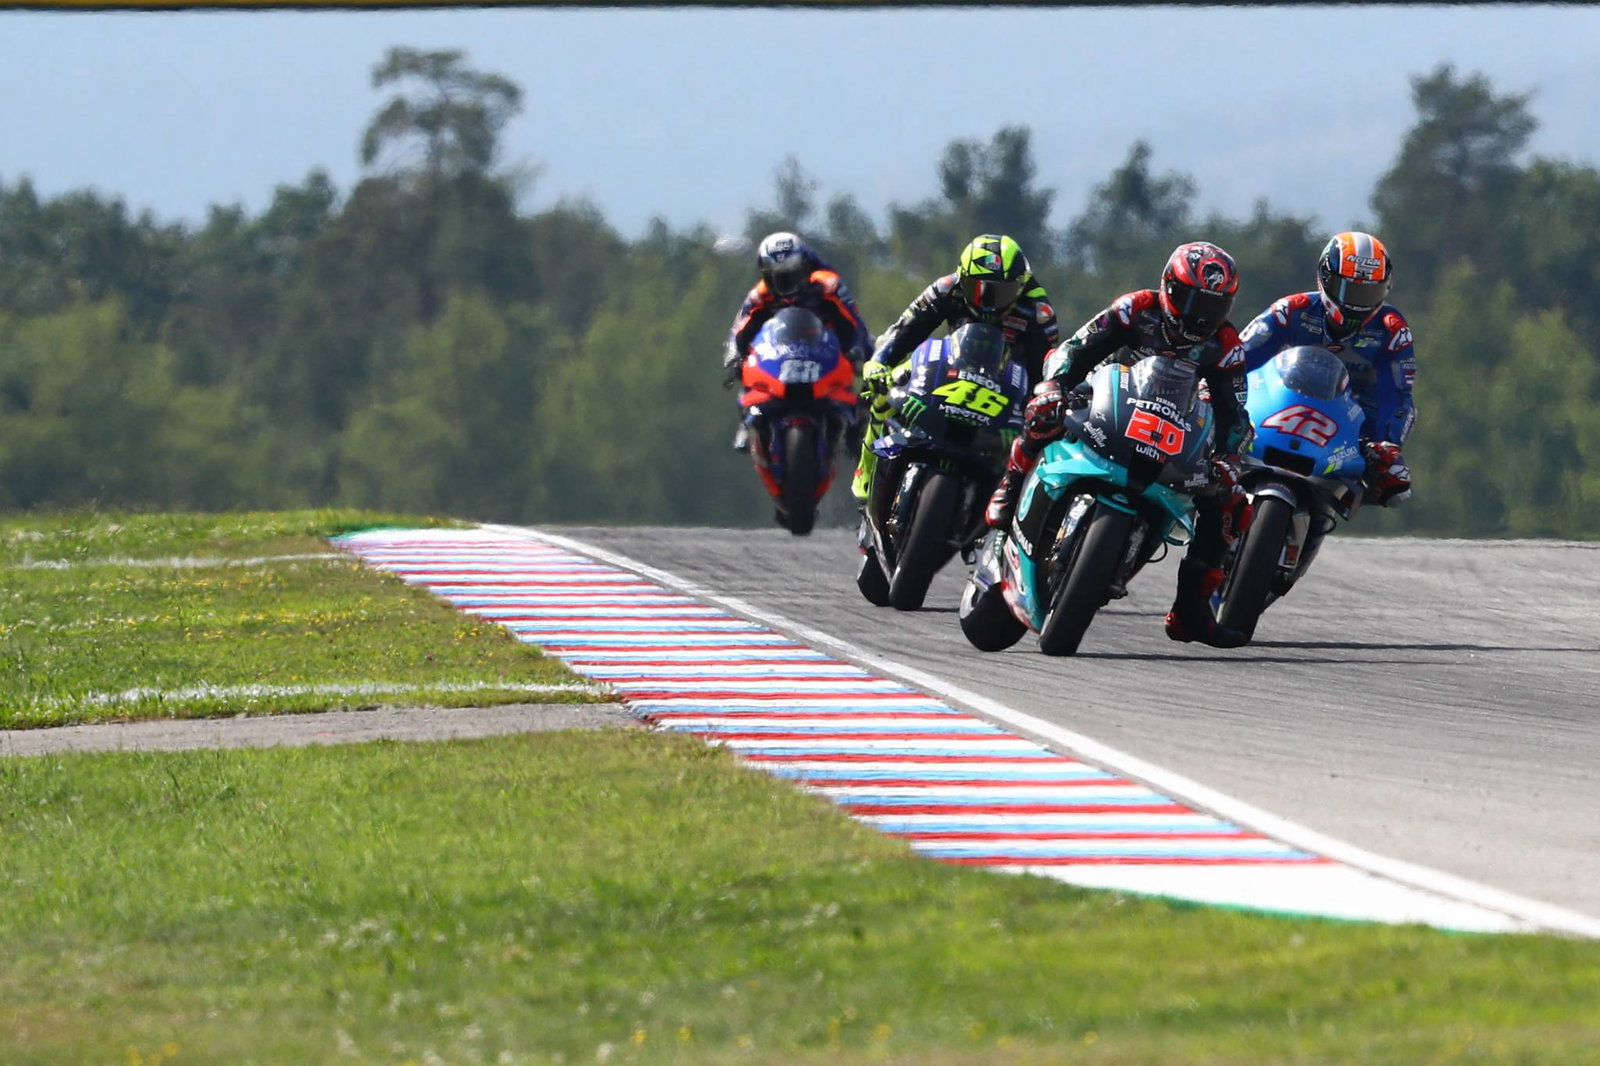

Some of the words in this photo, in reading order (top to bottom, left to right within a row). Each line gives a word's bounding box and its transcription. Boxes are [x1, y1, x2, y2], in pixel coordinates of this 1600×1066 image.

[1346, 255, 1381, 269] NOLAN
[957, 370, 1002, 394] ENEOS
[932, 379, 1010, 417] 46
[938, 403, 991, 425] MONSTER
[1126, 397, 1192, 432] PETRONAS
[1260, 404, 1339, 448] 42
[1124, 407, 1185, 456] 20
[1327, 446, 1358, 463] SUZUKI
